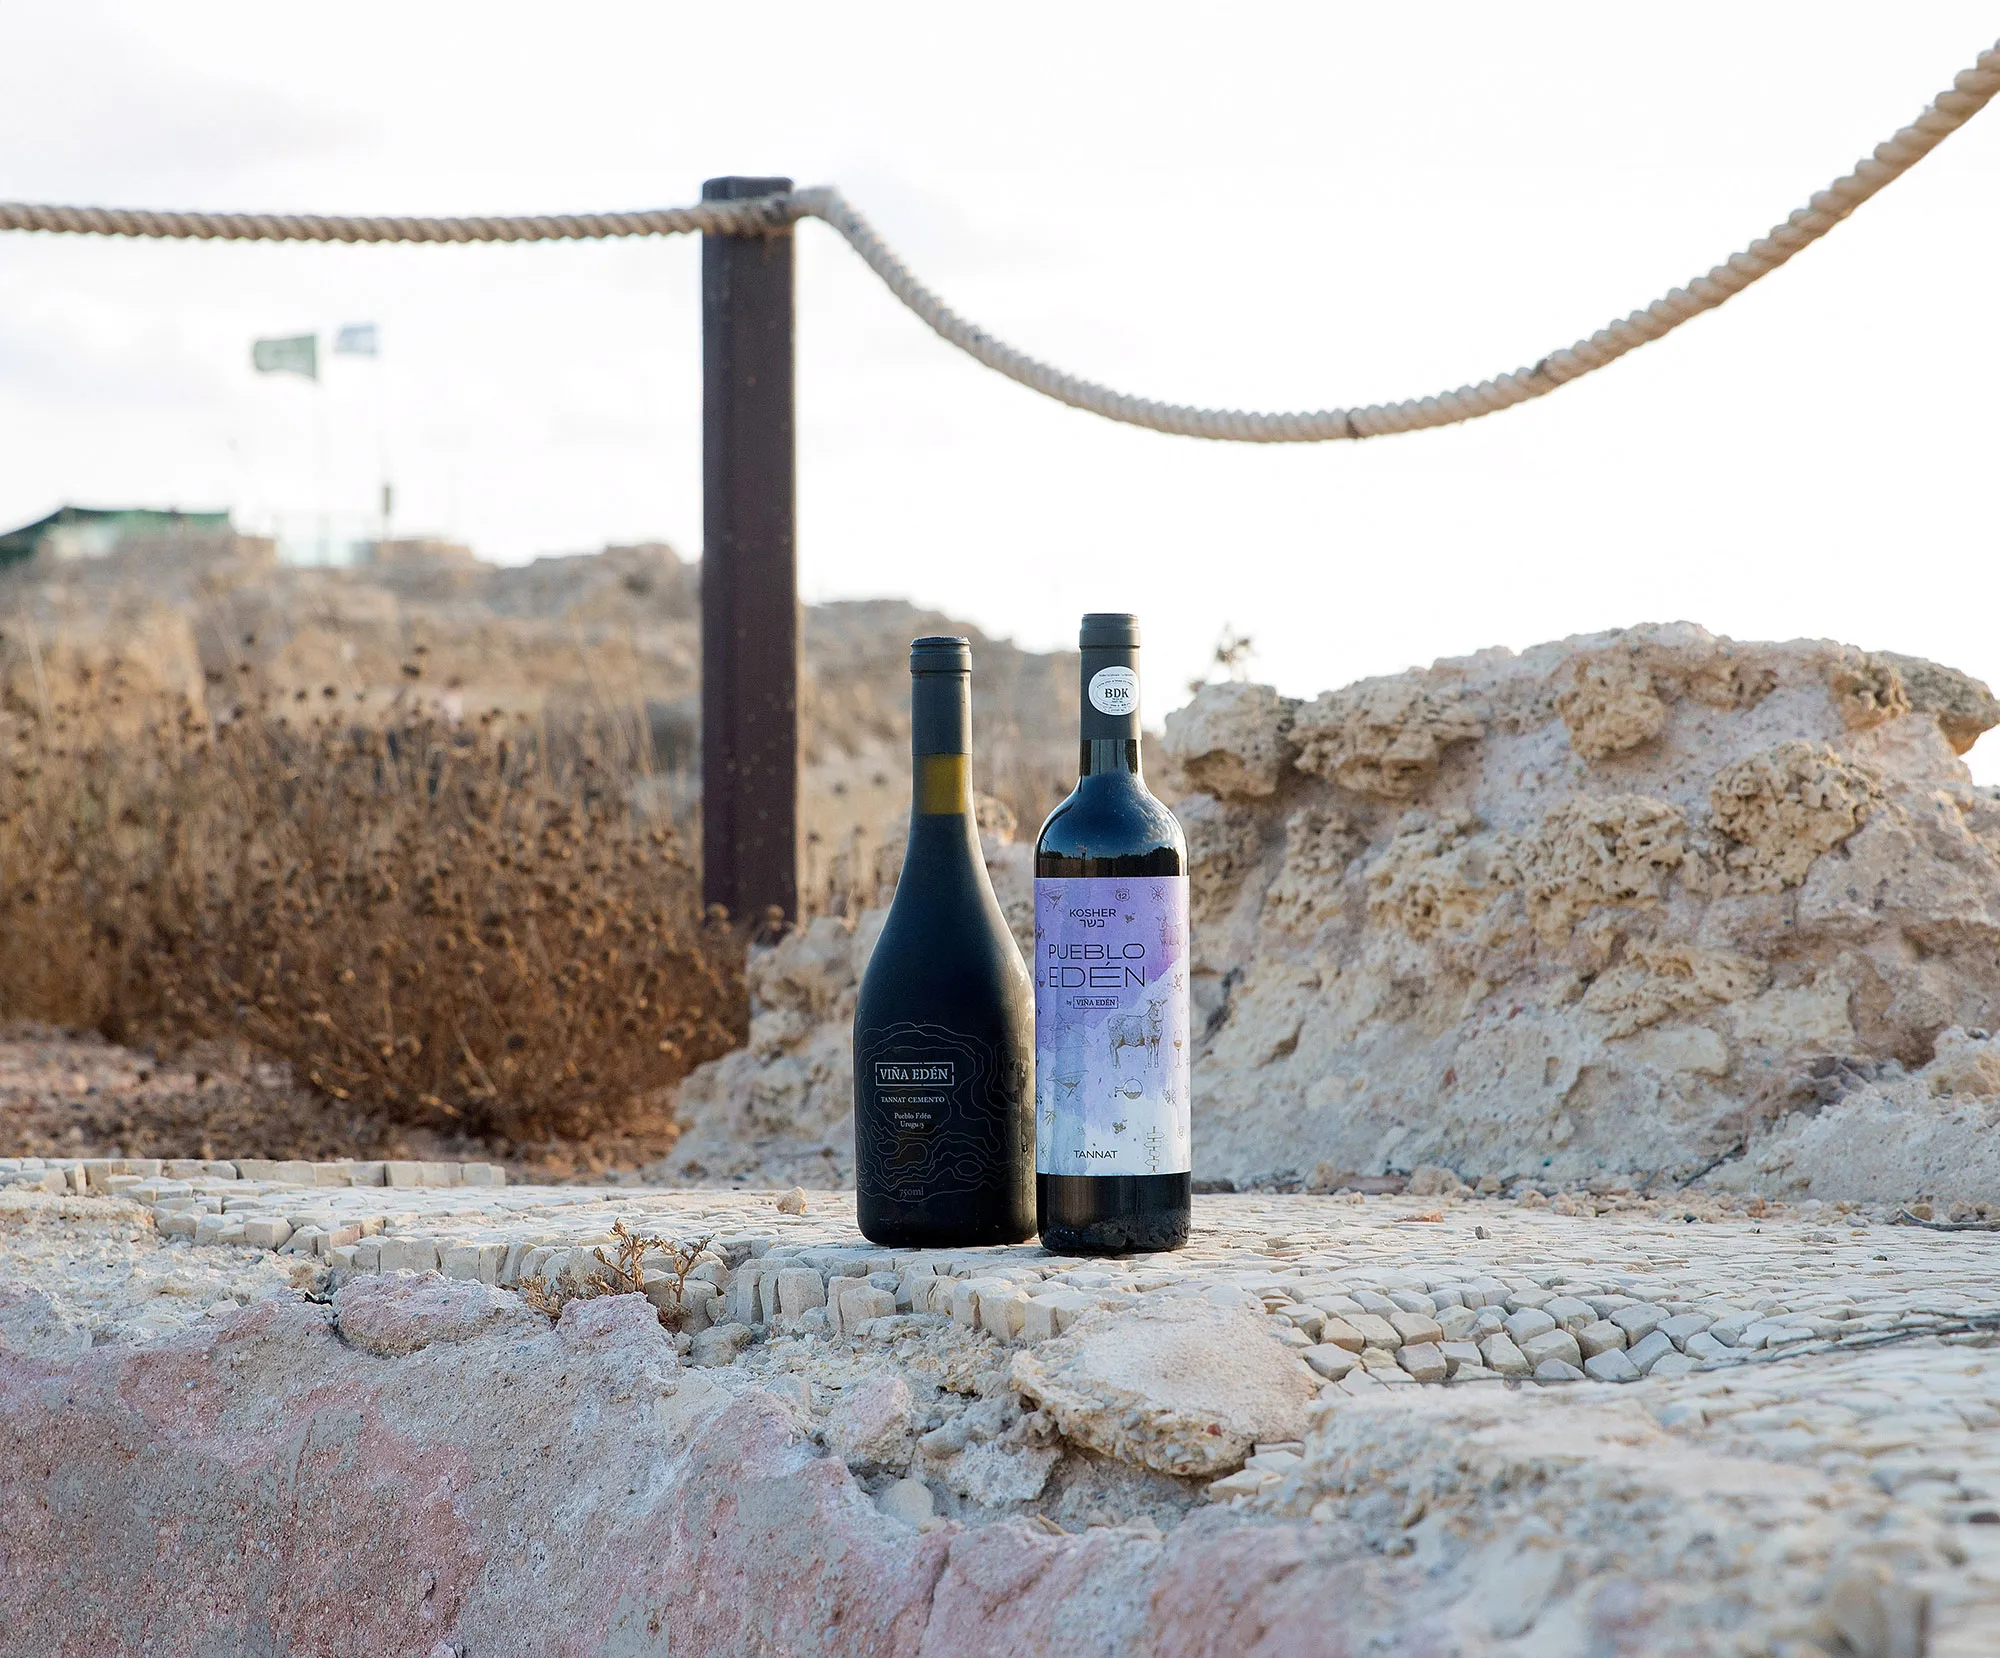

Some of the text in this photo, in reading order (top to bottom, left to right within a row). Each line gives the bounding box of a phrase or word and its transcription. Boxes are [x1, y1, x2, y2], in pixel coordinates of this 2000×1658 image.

[1105, 688, 1128, 698] BDK
[1069, 909, 1117, 917] KOSHER
[1079, 919, 1105, 928] כשר
[1048, 943, 1145, 960] PUEBLO
[1049, 961, 1145, 988] EDÉN
[1075, 998, 1095, 1006] VIÑA
[1096, 998, 1116, 1006] EDÉN
[879, 1066, 948, 1080] VIÑA EDÉN
[900, 1120, 925, 1129] Uruguy
[1073, 1150, 1118, 1159] TANNAT
[899, 1186, 924, 1198] 750ml
